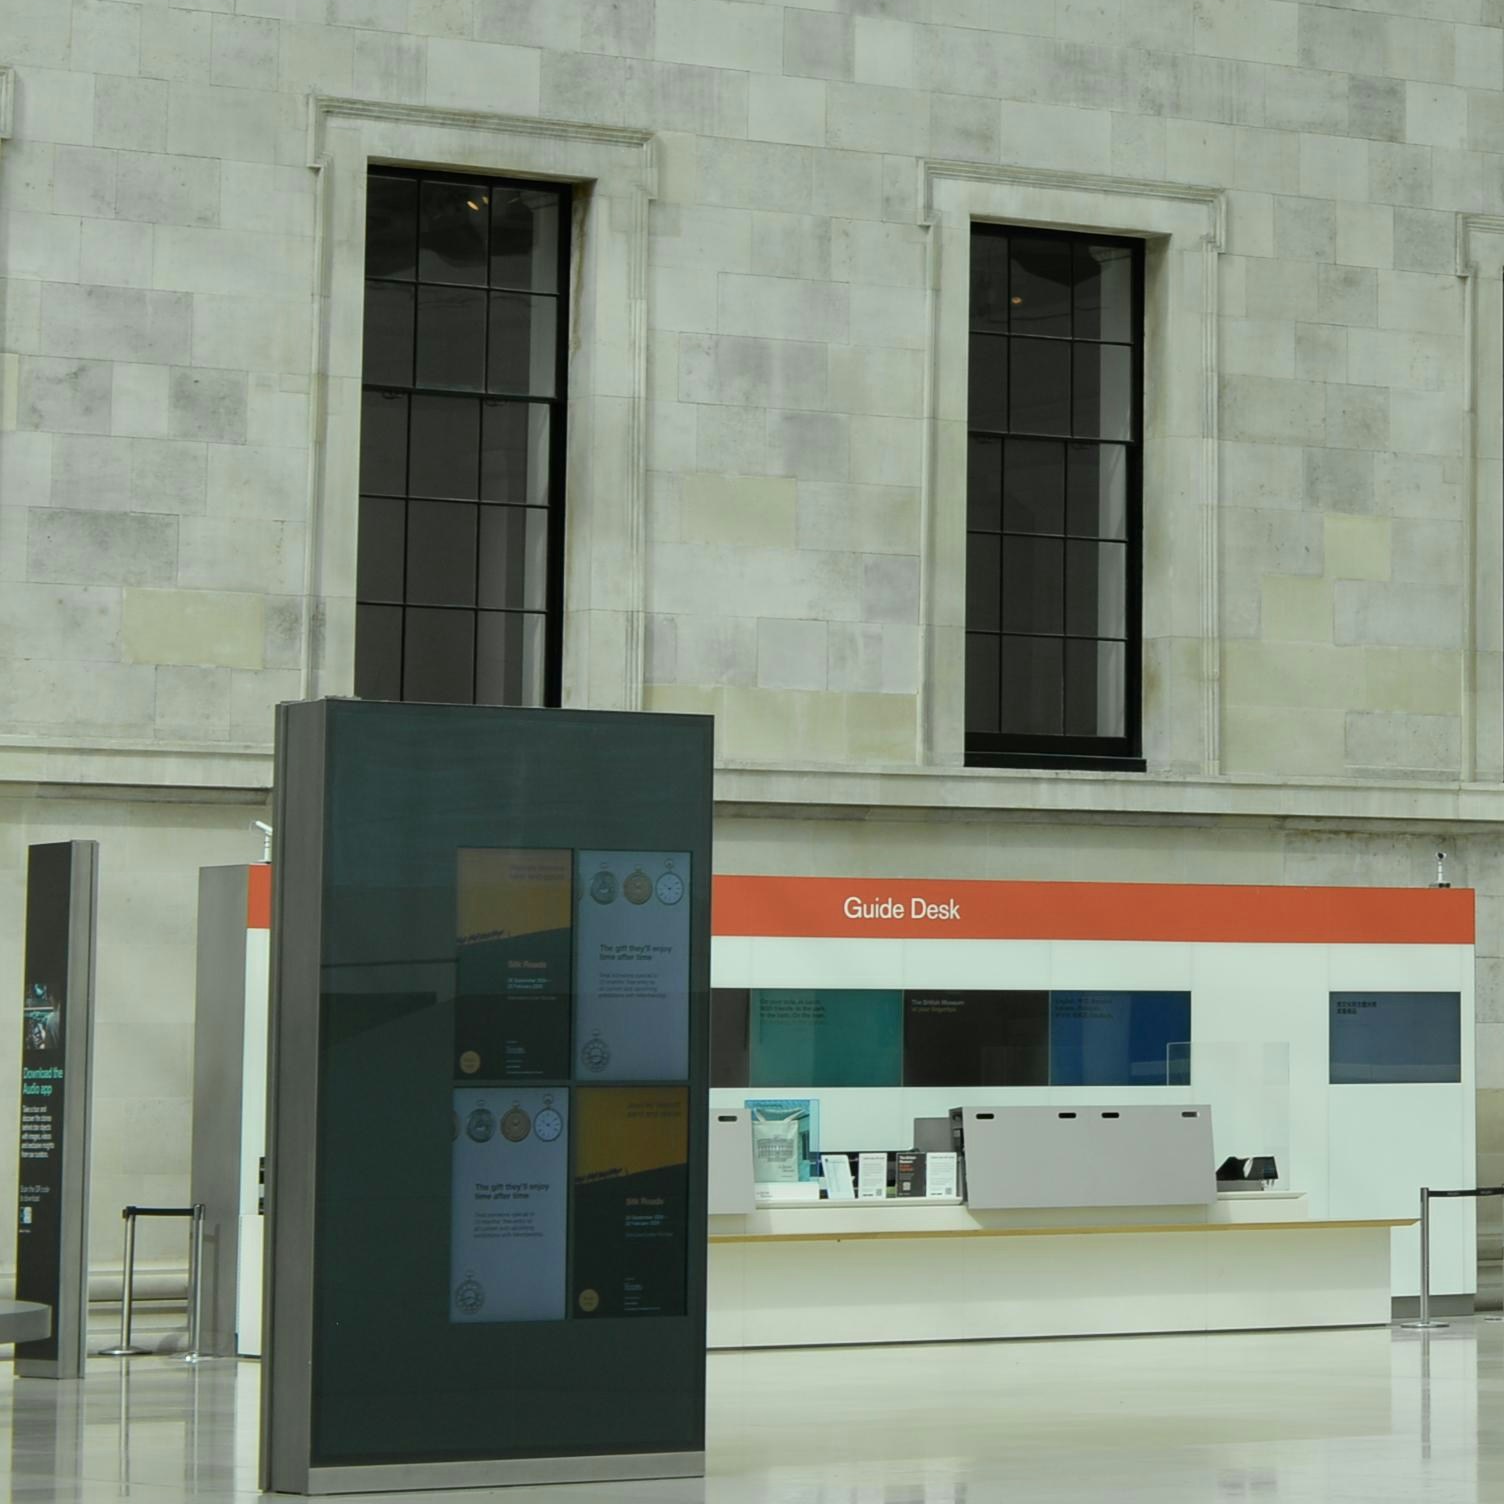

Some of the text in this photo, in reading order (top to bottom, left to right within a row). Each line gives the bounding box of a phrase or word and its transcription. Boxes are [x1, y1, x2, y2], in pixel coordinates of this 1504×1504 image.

[843, 896, 960, 920] Guide Desk
[600, 944, 613, 952] The
[615, 945, 628, 954] gift
[652, 946, 672, 955] enjoy
[617, 953, 634, 961] after
[23, 1067, 64, 1079] Download the
[23, 1082, 53, 1097] Audio app
[529, 1183, 550, 1193] enjoy
